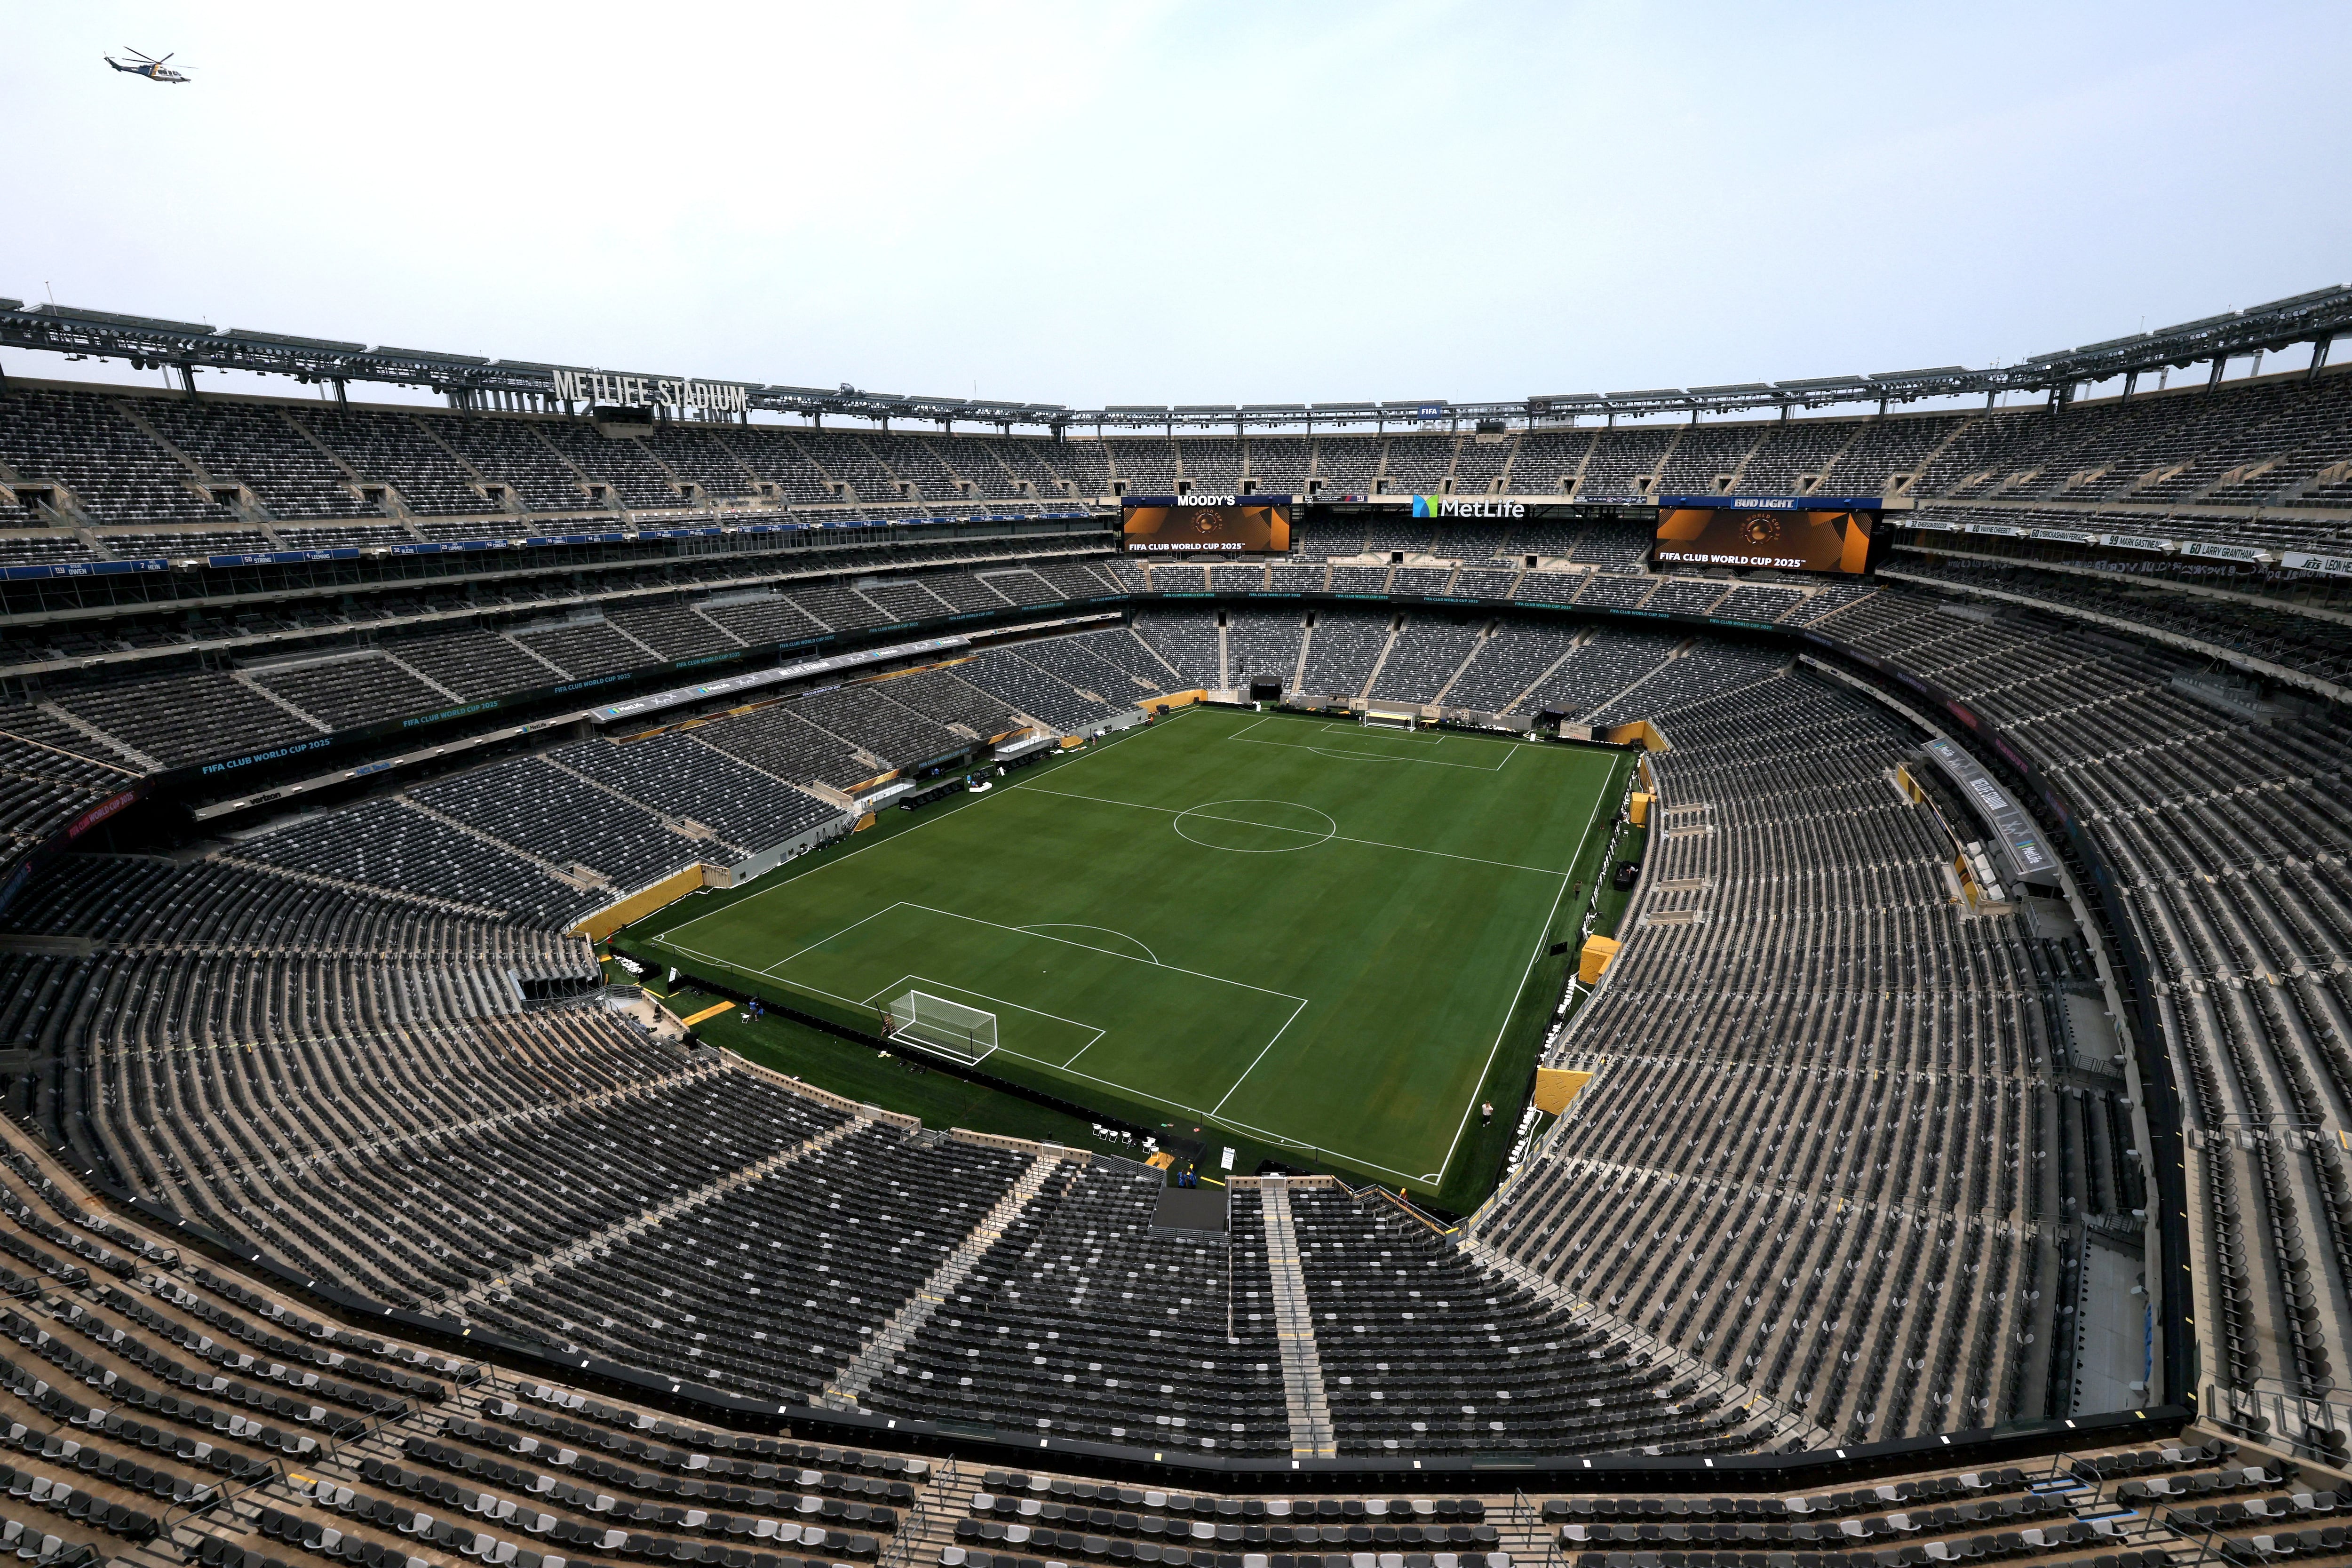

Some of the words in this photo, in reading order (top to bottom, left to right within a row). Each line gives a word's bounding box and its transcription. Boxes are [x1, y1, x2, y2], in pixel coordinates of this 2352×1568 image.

[552, 370, 652, 406] METLIFE
[659, 380, 747, 411] STADIUM
[1177, 495, 1235, 506] MOODY'S
[1734, 499, 1758, 507] BUD
[1440, 499, 1525, 517] MetLife
[1772, 518, 1780, 530] CUP
[2032, 529, 2039, 537] 60
[2109, 535, 2119, 545] 99
[2119, 537, 2134, 547] MARK
[2190, 543, 2201, 554] 60
[2202, 546, 2222, 557] LARRY
[2222, 548, 2255, 559] GRANTHAM
[1660, 552, 1681, 560] FIFA
[1683, 553, 1708, 562] CLUB
[1711, 555, 1748, 565] WORLD
[1750, 557, 1772, 565] CUP
[2325, 559, 2343, 571] LEON
[701, 655, 718, 664] WORLD
[778, 665, 805, 676] METLIFE
[805, 661, 830, 671] STADIUM
[584, 678, 604, 687] WORLD
[707, 683, 730, 692] MetLife
[618, 702, 644, 712] MetLife
[403, 719, 420, 728] FIFA
[421, 714, 439, 723] CLUB
[440, 708, 465, 719] WORLD
[202, 763, 225, 774] FIFA
[227, 757, 252, 768] CLUB
[253, 748, 287, 762] WORLD
[289, 745, 306, 754] CUP
[1970, 778, 1994, 795] METLIFE
[249, 792, 281, 805] verizon
[1981, 791, 2008, 810] STADIUM
[70, 829, 80, 837] FIFA
[79, 818, 90, 832] CLUB
[88, 805, 109, 822] WORLD
[109, 799, 120, 812] CUP
[2022, 846, 2042, 864] MetLife
